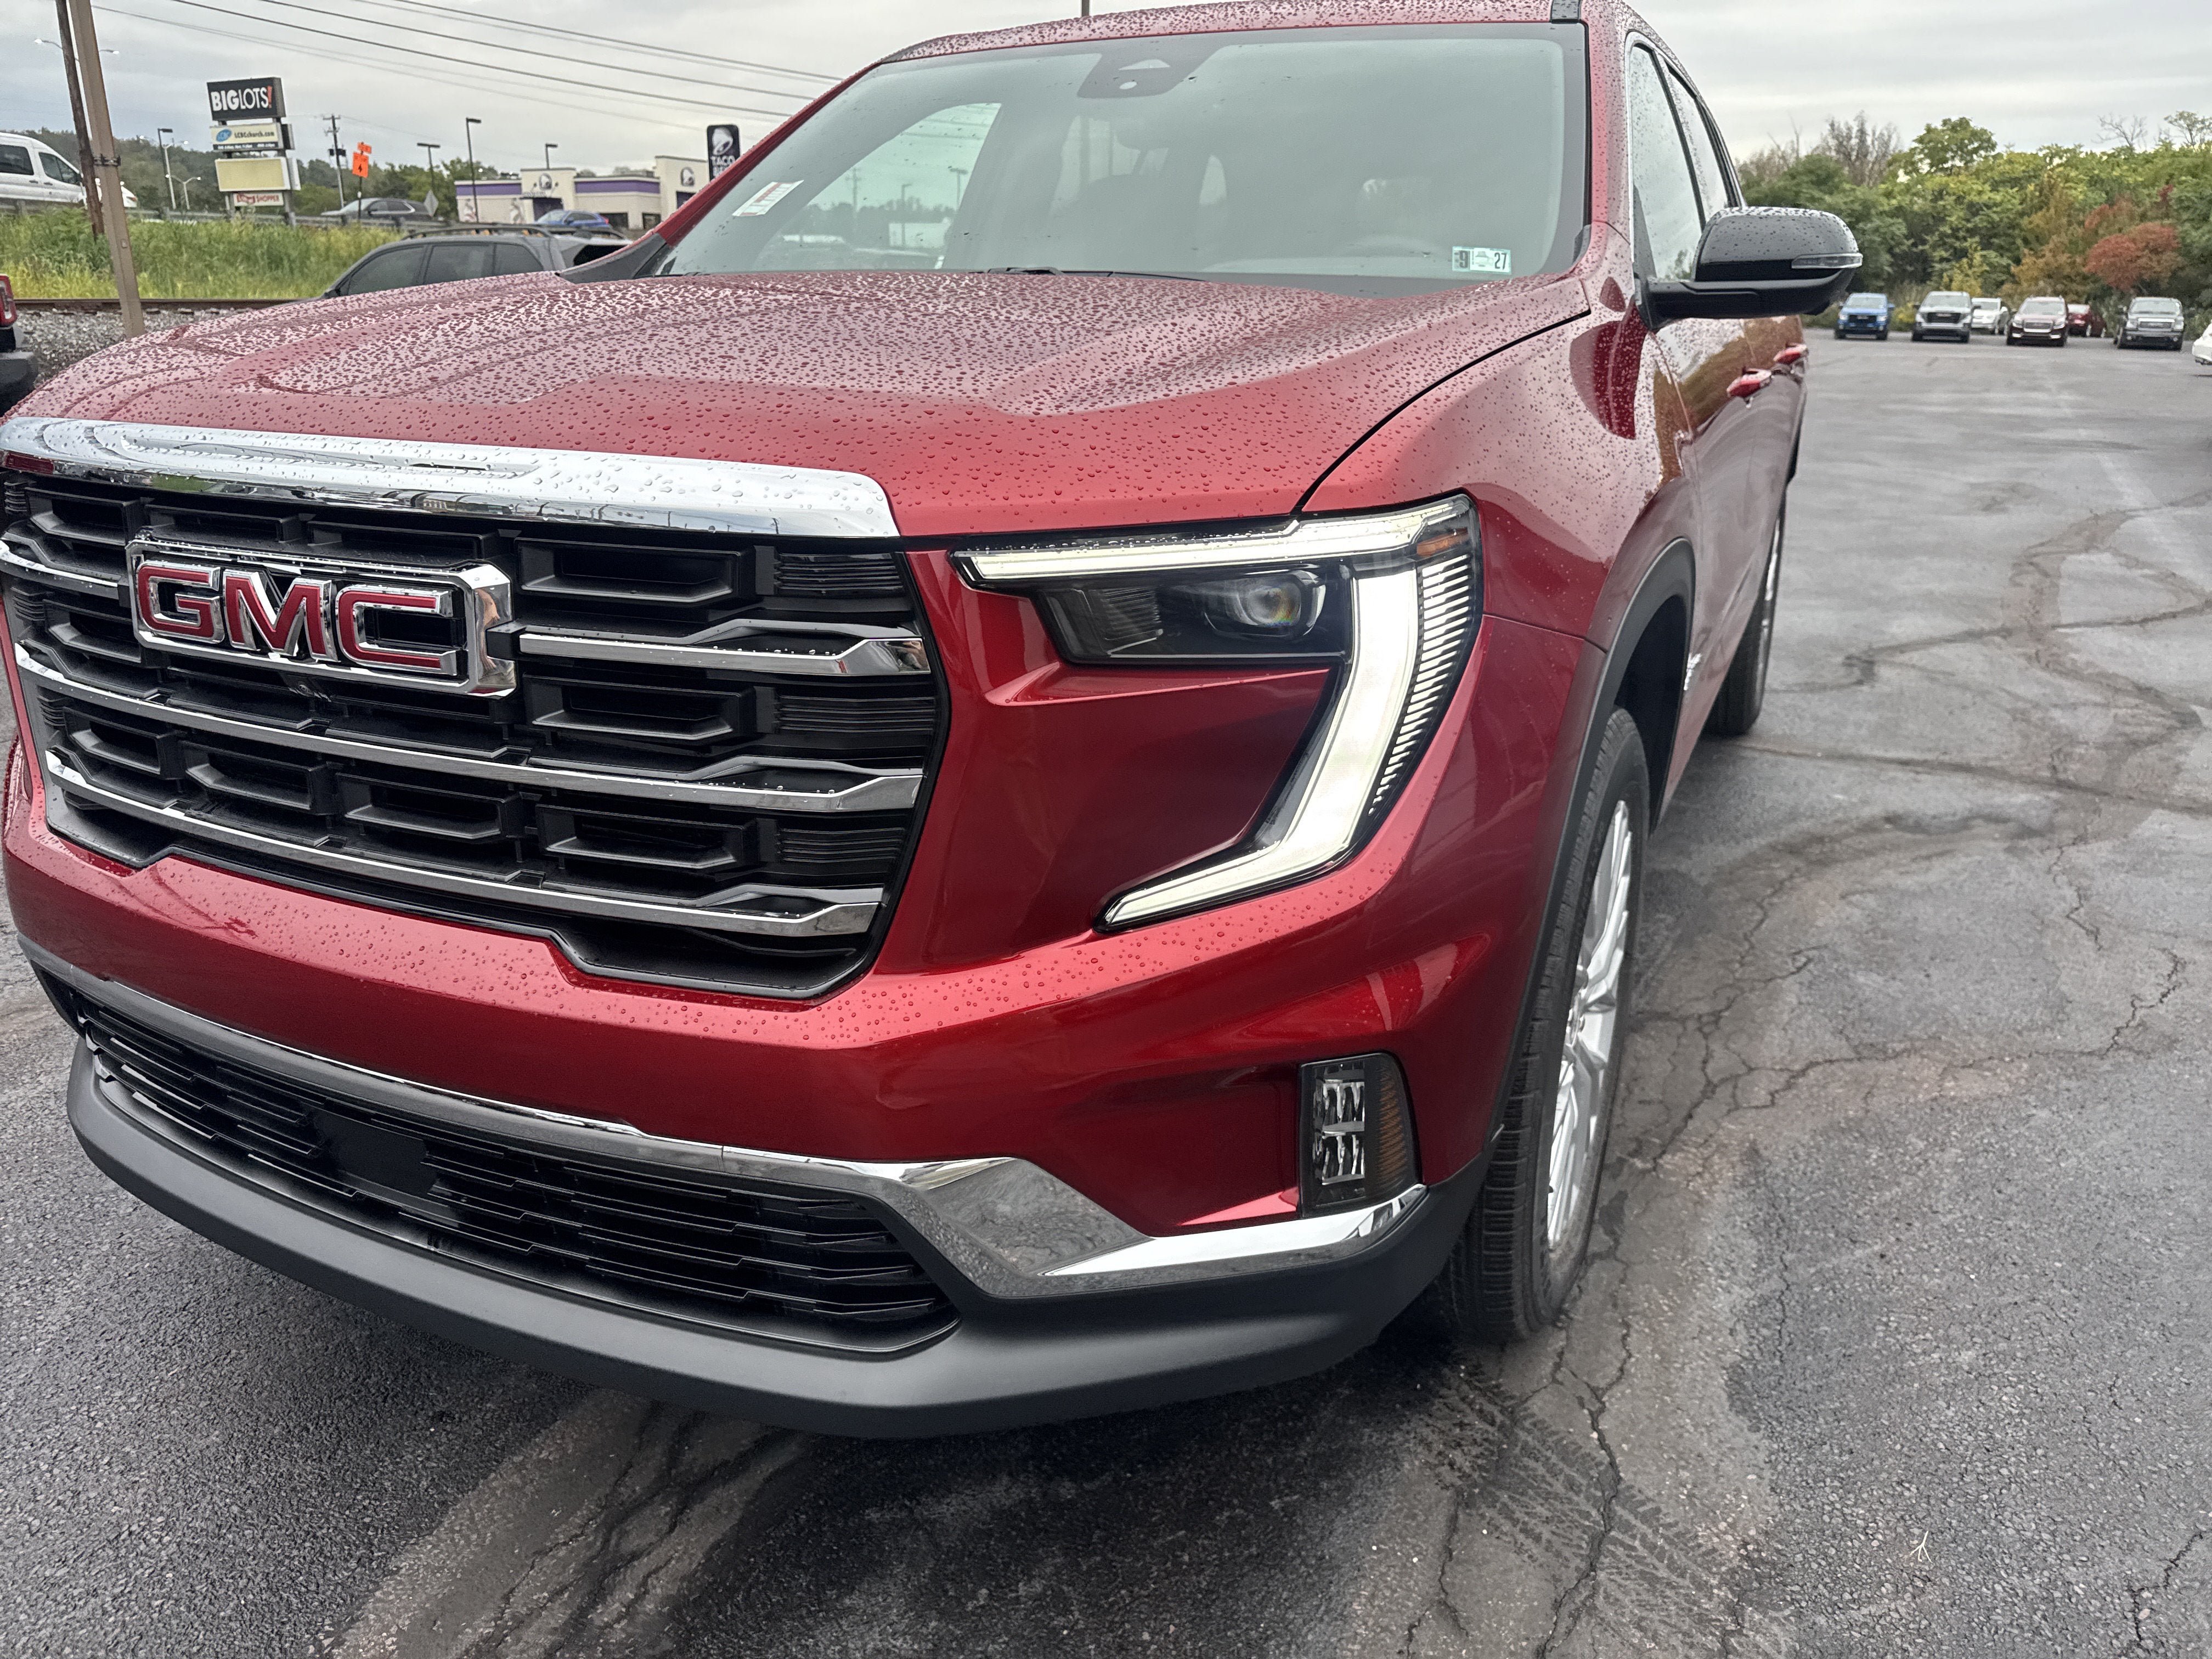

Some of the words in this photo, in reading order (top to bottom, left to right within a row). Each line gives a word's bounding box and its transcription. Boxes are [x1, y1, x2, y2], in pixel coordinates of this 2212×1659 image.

[710, 155, 735, 166] TACO
[1459, 250, 1469, 268] 9
[1494, 252, 1507, 270] 27
[137, 560, 458, 676] GMC
